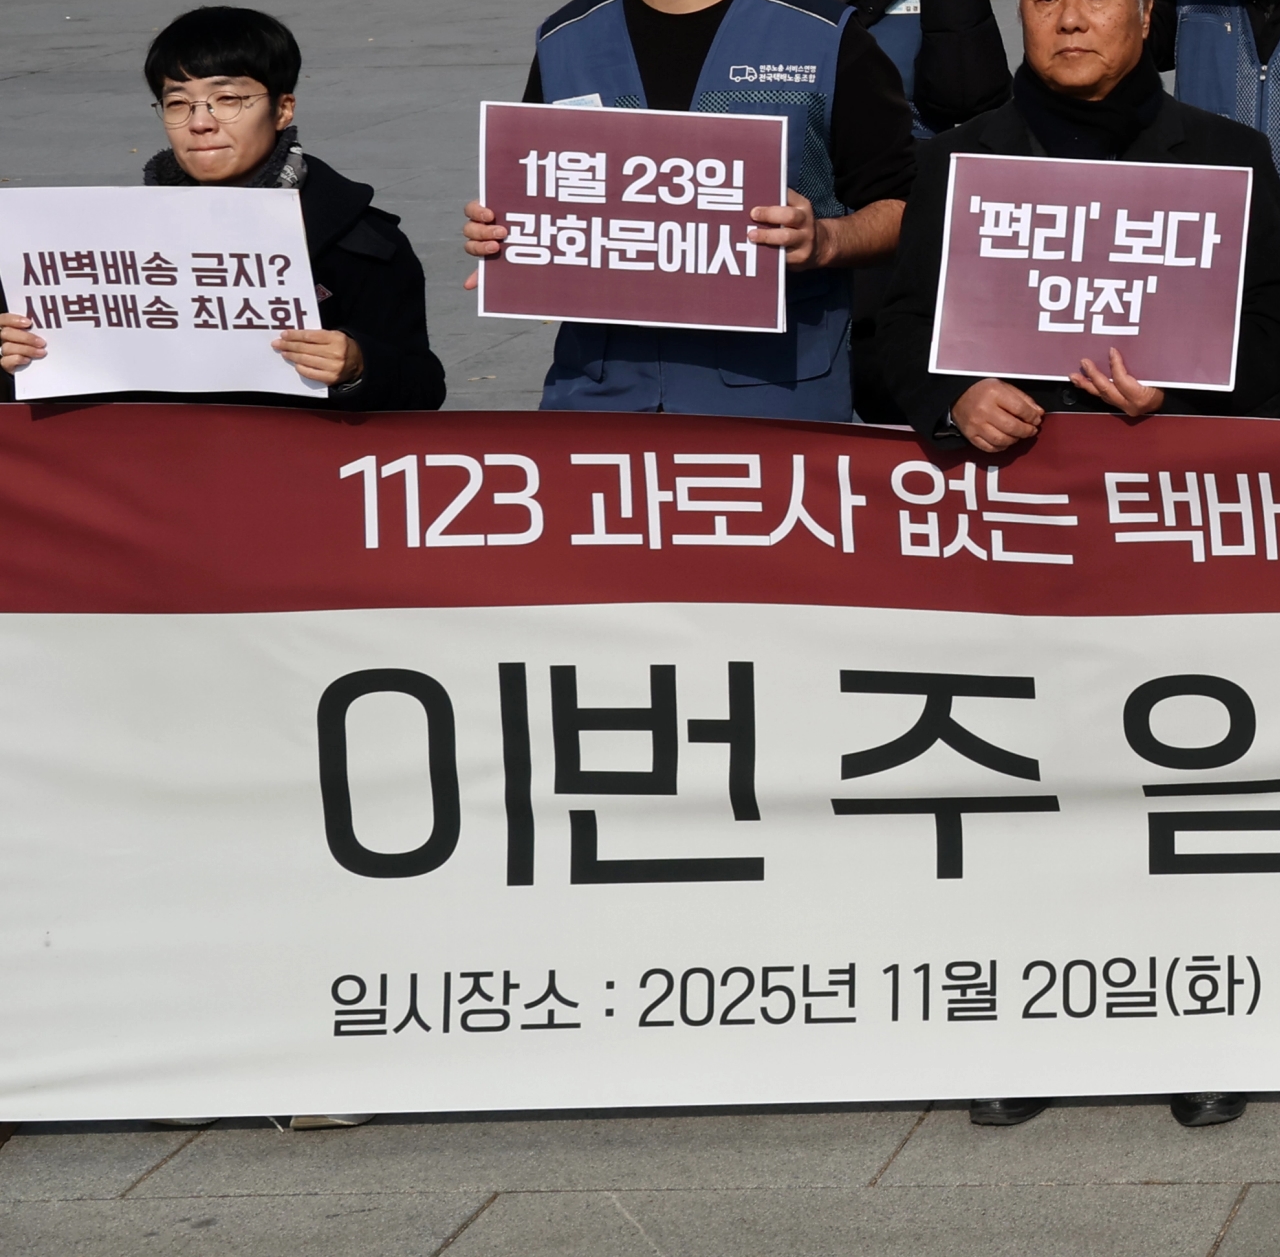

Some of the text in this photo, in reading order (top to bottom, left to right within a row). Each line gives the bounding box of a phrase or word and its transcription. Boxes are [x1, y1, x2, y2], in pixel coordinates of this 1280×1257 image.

[759, 74, 816, 84] 전국택배노동조합
[519, 150, 744, 211] 11월 23일
[504, 212, 758, 277] 광화문에서
[969, 195, 1222, 269] '편리' 보다
[22, 251, 292, 288] 새벽배송 금지?
[1028, 269, 1158, 336] '안전'
[24, 294, 308, 331] 새벽배송 최소화
[340, 454, 543, 548] 1123
[571, 452, 866, 553] 과로사
[891, 461, 1078, 564] 없는
[317, 661, 764, 886] 이번
[831, 670, 1060, 879] 주
[331, 970, 581, 1036] 일시장소
[639, 963, 856, 1027] 2025년
[883, 960, 997, 1021] 11월
[1022, 955, 1260, 1018] 20일(화)
